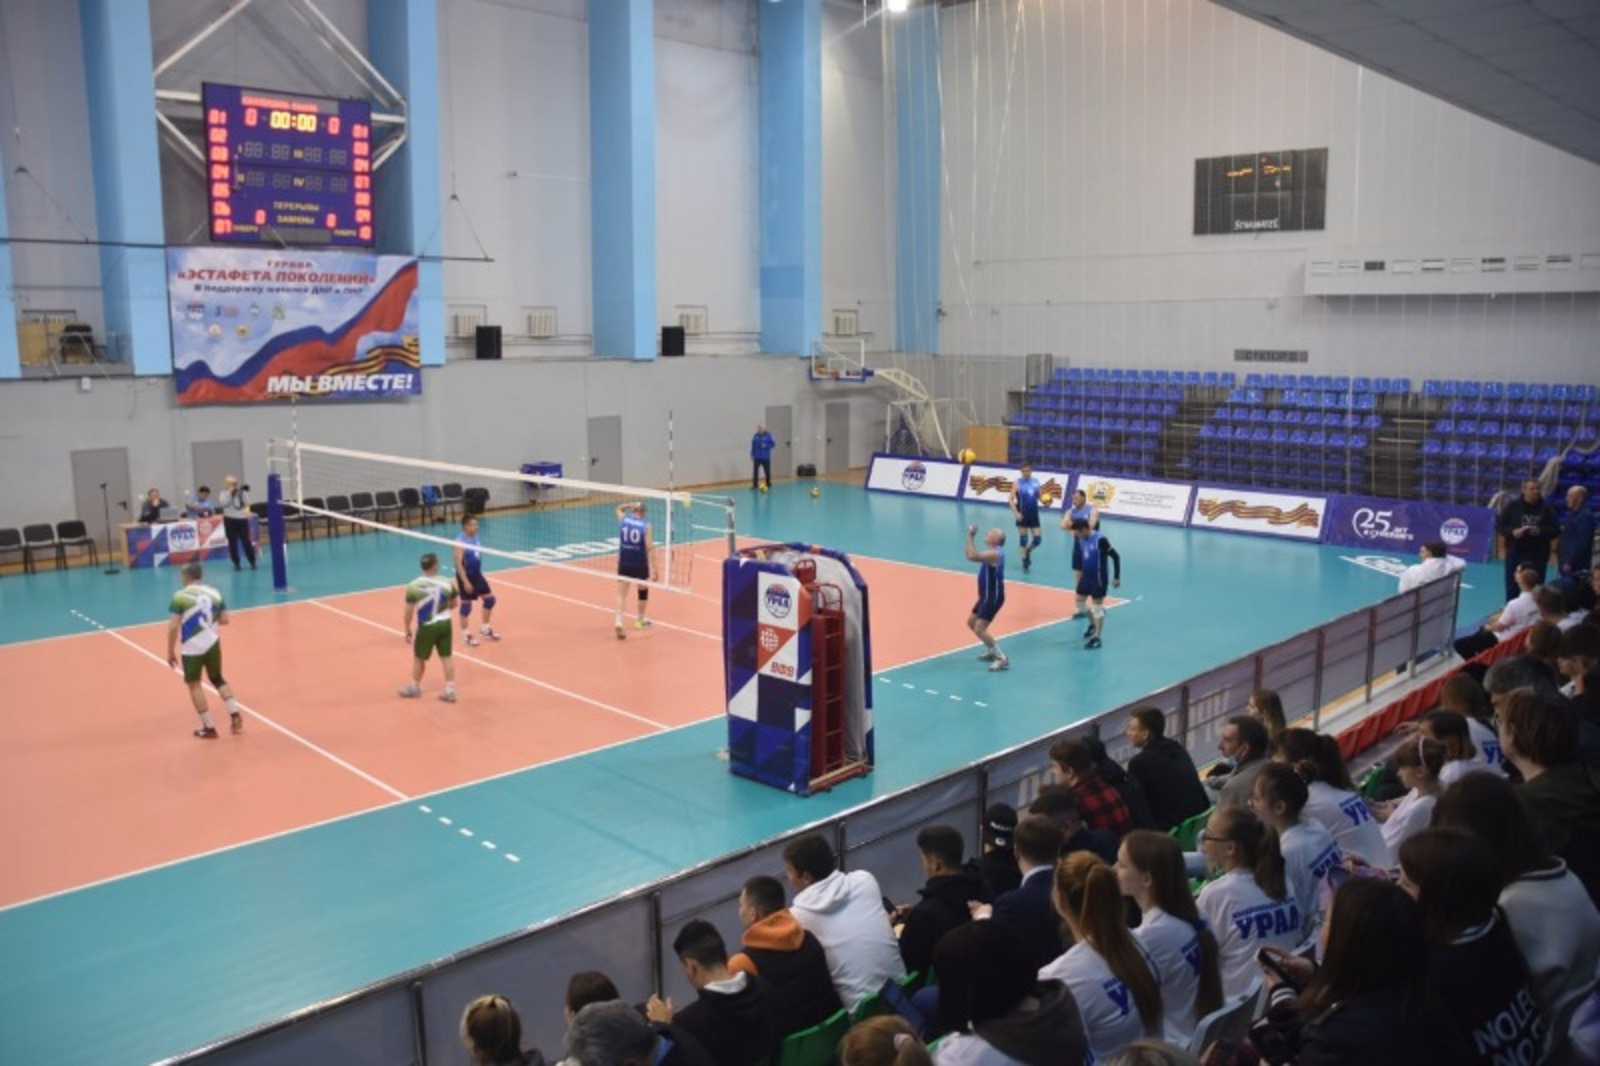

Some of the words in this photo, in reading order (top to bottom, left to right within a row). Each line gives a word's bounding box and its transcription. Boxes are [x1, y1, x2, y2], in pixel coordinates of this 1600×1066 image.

[245, 107, 257, 126] 0
[270, 111, 317, 132] 00:00
[328, 116, 340, 135] 0
[255, 209, 266, 225] 0
[326, 213, 337, 228] 0
[177, 268, 272, 282] «ЭСТАФЕТА
[267, 375, 314, 393] МЫ
[316, 374, 414, 392] ВМЕСТЕ!
[1352, 508, 1393, 538] 25
[621, 527, 641, 544] 10
